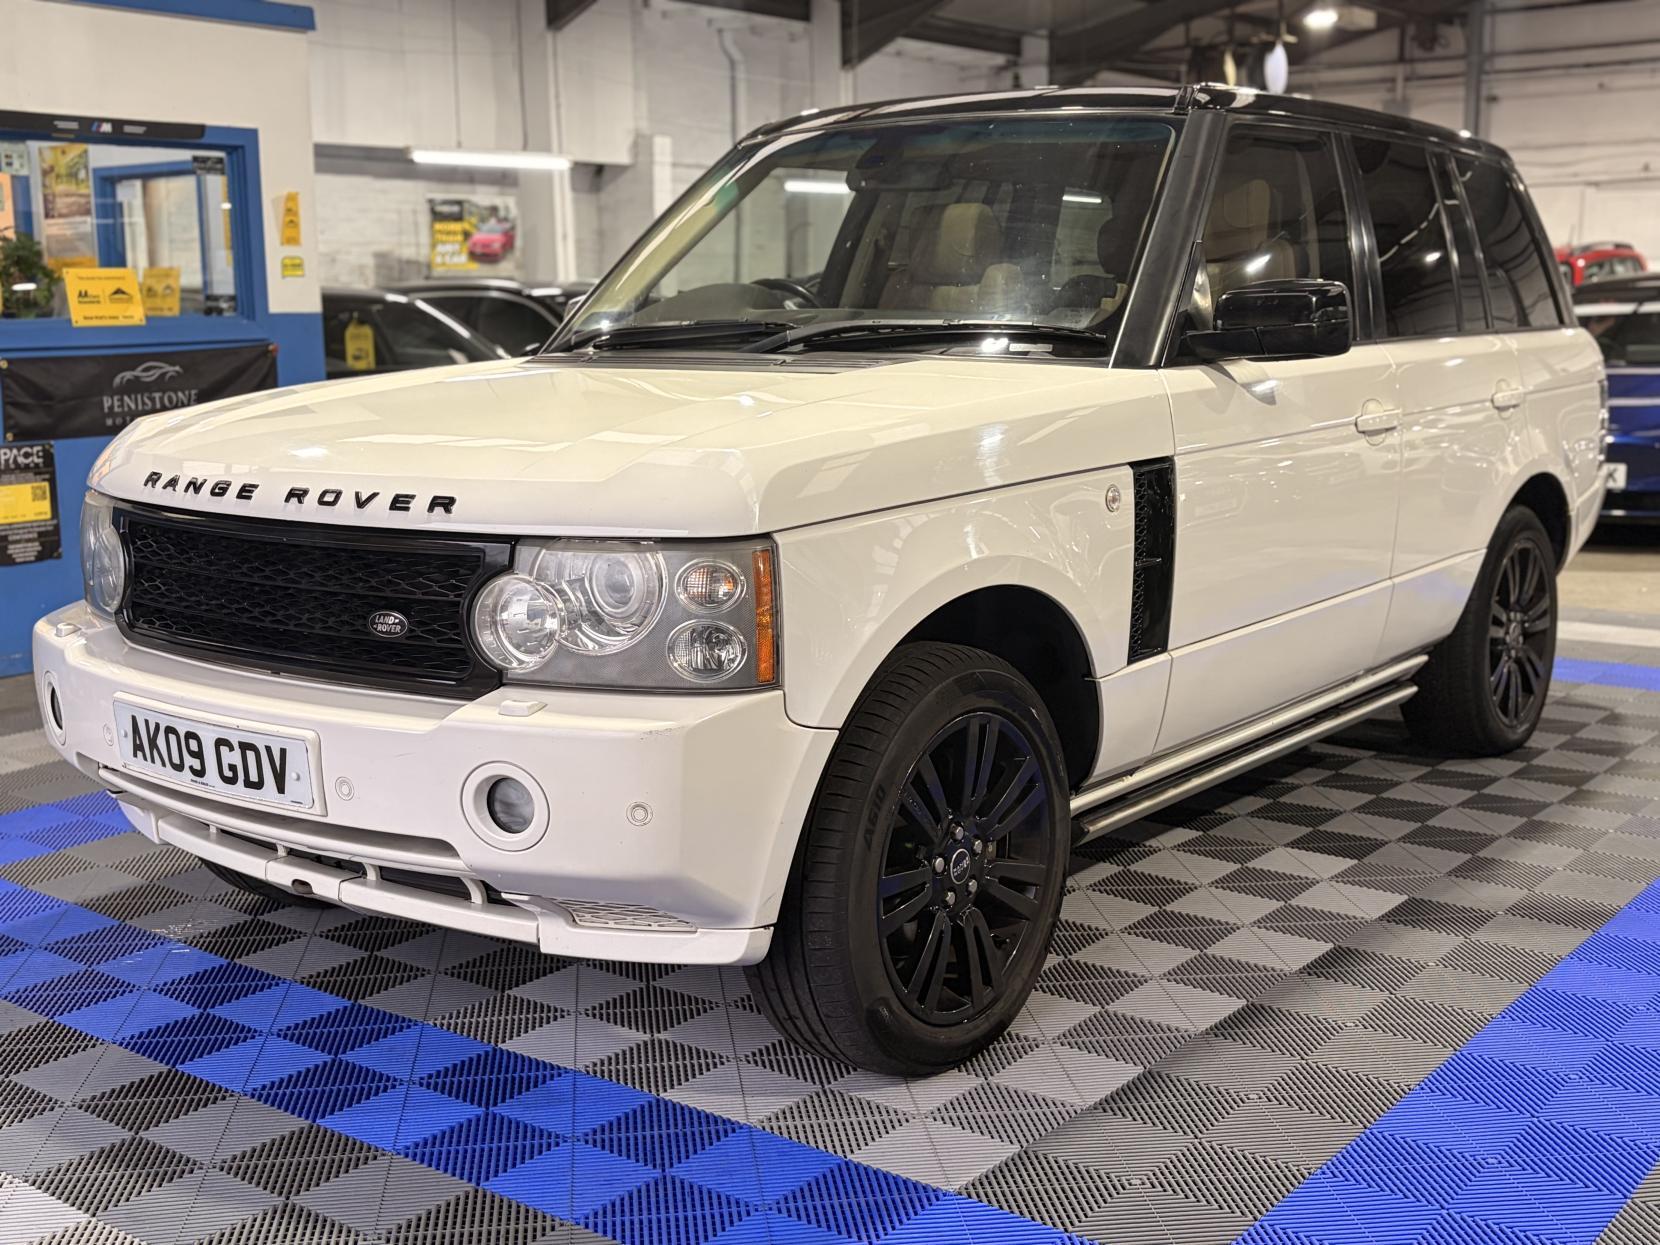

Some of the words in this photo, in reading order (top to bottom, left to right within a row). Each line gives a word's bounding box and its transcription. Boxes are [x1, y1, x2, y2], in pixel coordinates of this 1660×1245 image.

[103, 389, 198, 413] PENISTONE
[106, 416, 131, 426] MOT
[143, 471, 260, 500] RANGE
[284, 486, 457, 514] ROVER
[375, 615, 395, 624] LAND
[377, 624, 402, 633] ROVER
[131, 714, 206, 778] AK09
[214, 736, 288, 795] GDV
